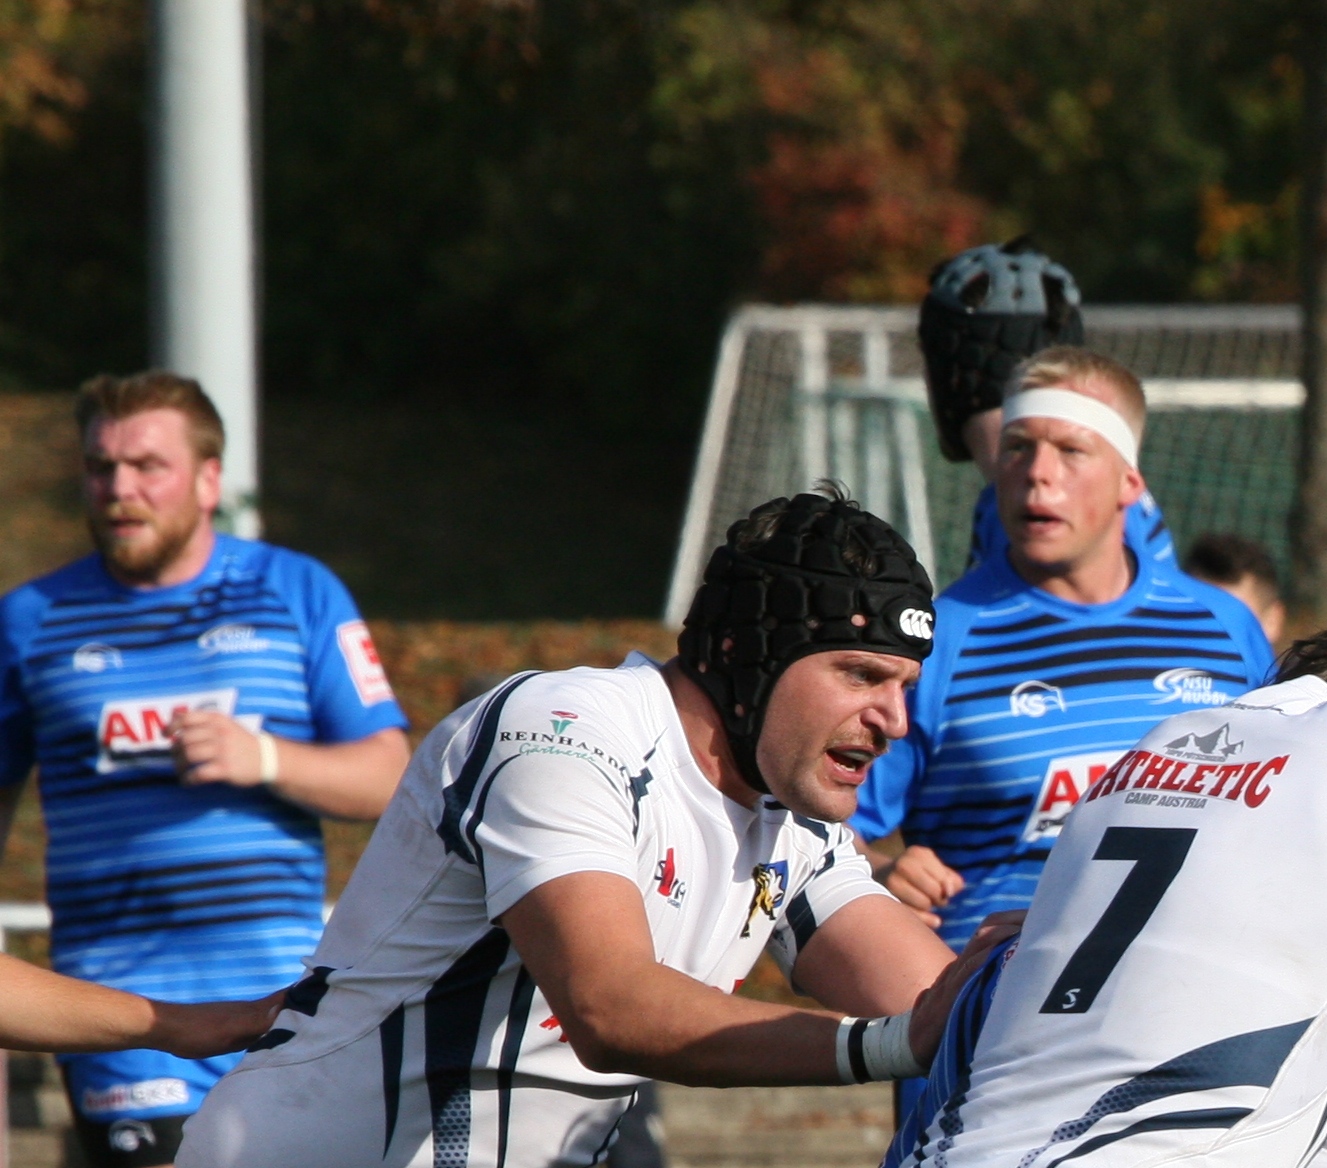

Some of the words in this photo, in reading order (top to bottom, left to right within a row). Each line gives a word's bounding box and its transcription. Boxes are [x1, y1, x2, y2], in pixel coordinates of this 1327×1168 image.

[1182, 676, 1212, 690] NSU
[1086, 750, 1290, 809] ATHLETIC
[1124, 792, 1158, 806] CAMP
[1158, 796, 1208, 809] AUSTRIA
[1038, 827, 1198, 1014] 7
